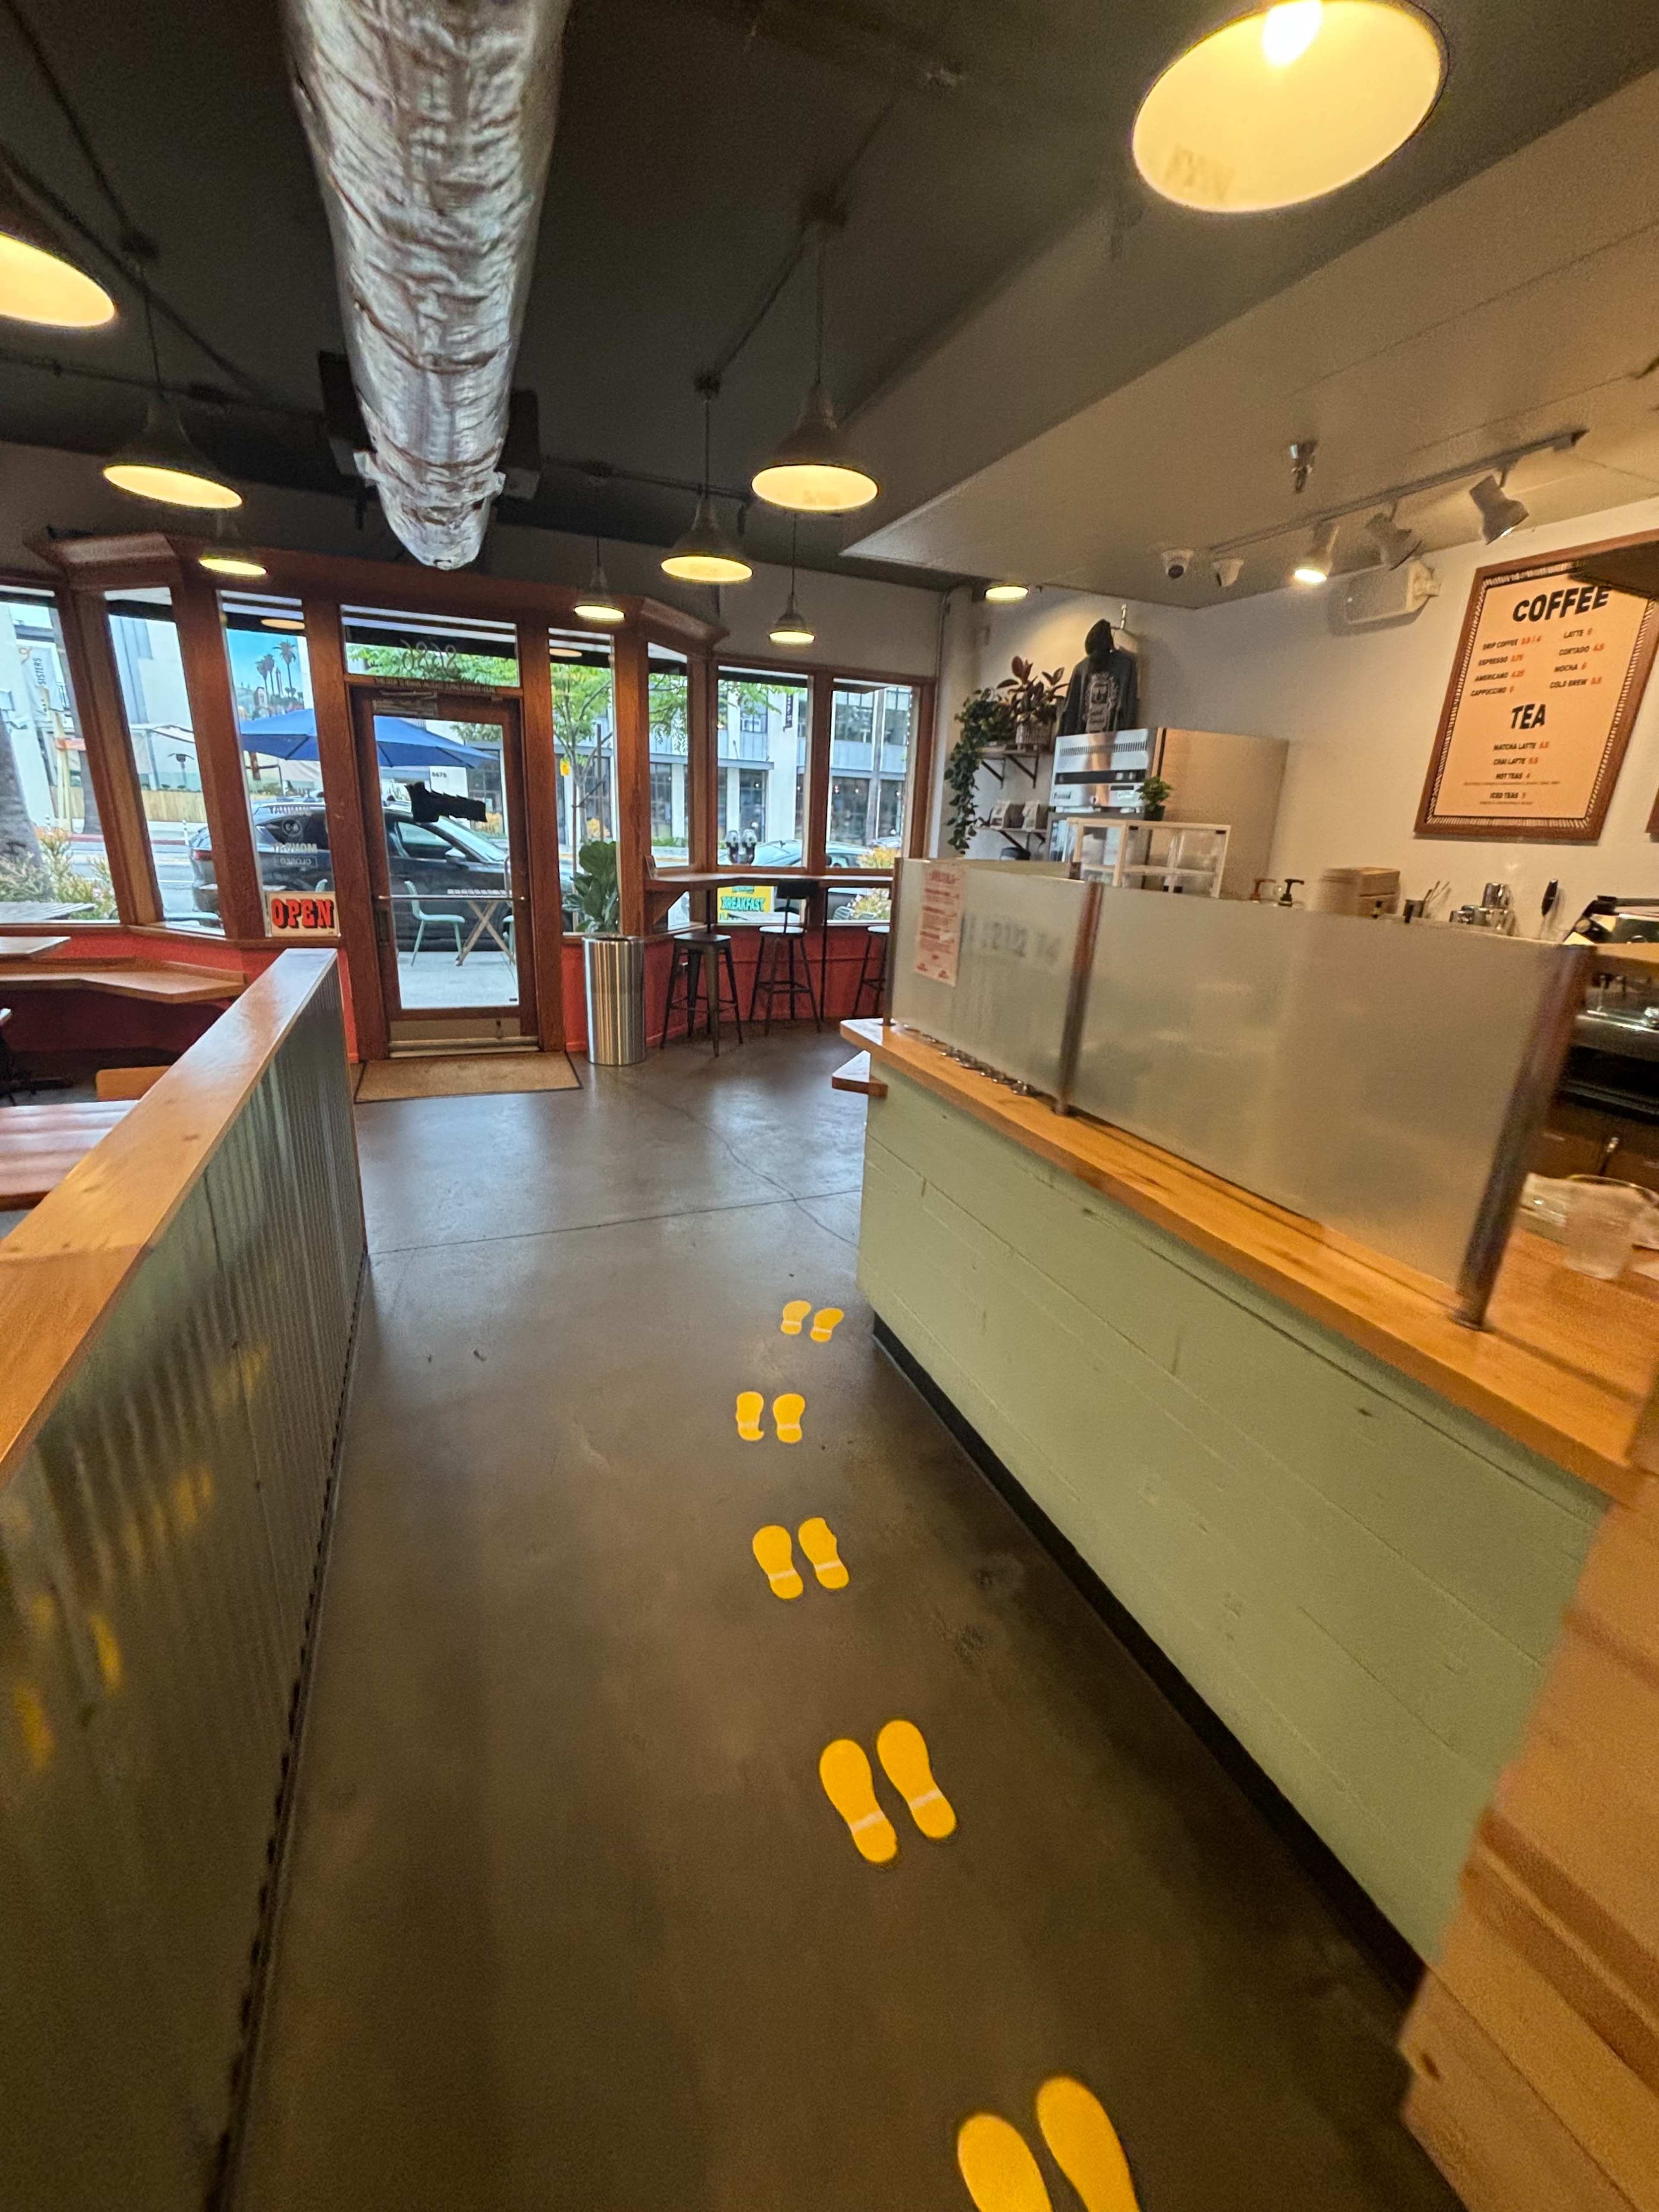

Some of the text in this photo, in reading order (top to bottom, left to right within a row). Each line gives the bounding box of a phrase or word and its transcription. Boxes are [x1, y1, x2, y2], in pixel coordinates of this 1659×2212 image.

[1513, 586, 1611, 622] COFFEE
[1564, 629, 1584, 639] LATTE
[1482, 642, 1496, 650] DRIP
[1497, 638, 1519, 648] COFFEE
[1559, 645, 1589, 656] CORTADO
[1478, 656, 1508, 666] ESPRESSO
[32, 657, 47, 685] SISTERS
[1554, 664, 1578, 672] MOCHA
[1474, 672, 1509, 682] AMERICANO
[1549, 680, 1567, 688] COLD
[1567, 678, 1588, 686] BREW
[1470, 687, 1507, 696] CAPPUCCINO
[1511, 703, 1546, 729] TEA
[720, 896, 766, 912] BREAKFAST
[271, 898, 334, 929] OPEN
